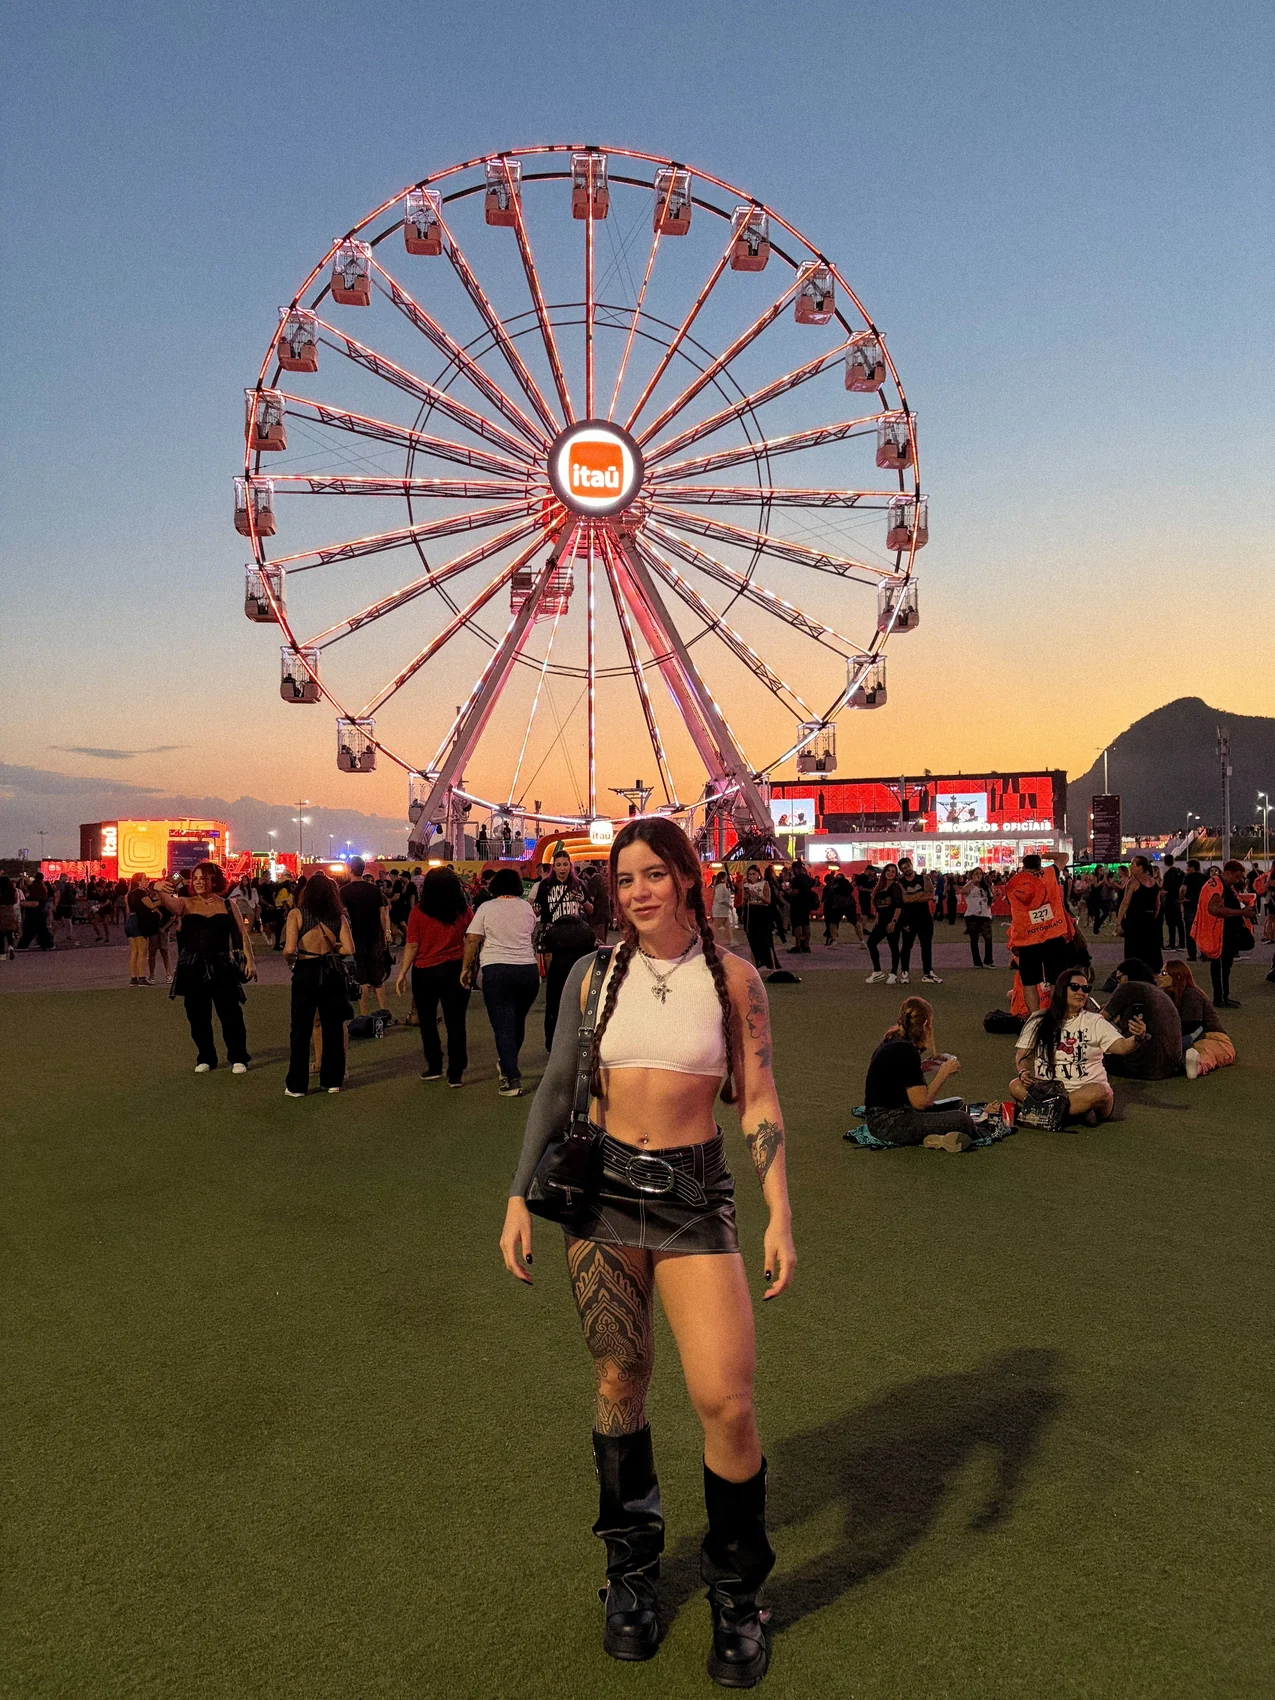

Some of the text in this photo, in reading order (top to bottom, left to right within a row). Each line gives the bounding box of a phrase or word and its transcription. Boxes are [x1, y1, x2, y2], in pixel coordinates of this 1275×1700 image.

[573, 463, 619, 488] itaú
[1002, 821, 1052, 832] OFICIAIS
[592, 831, 611, 840] itaú
[1033, 909, 1048, 919] 227
